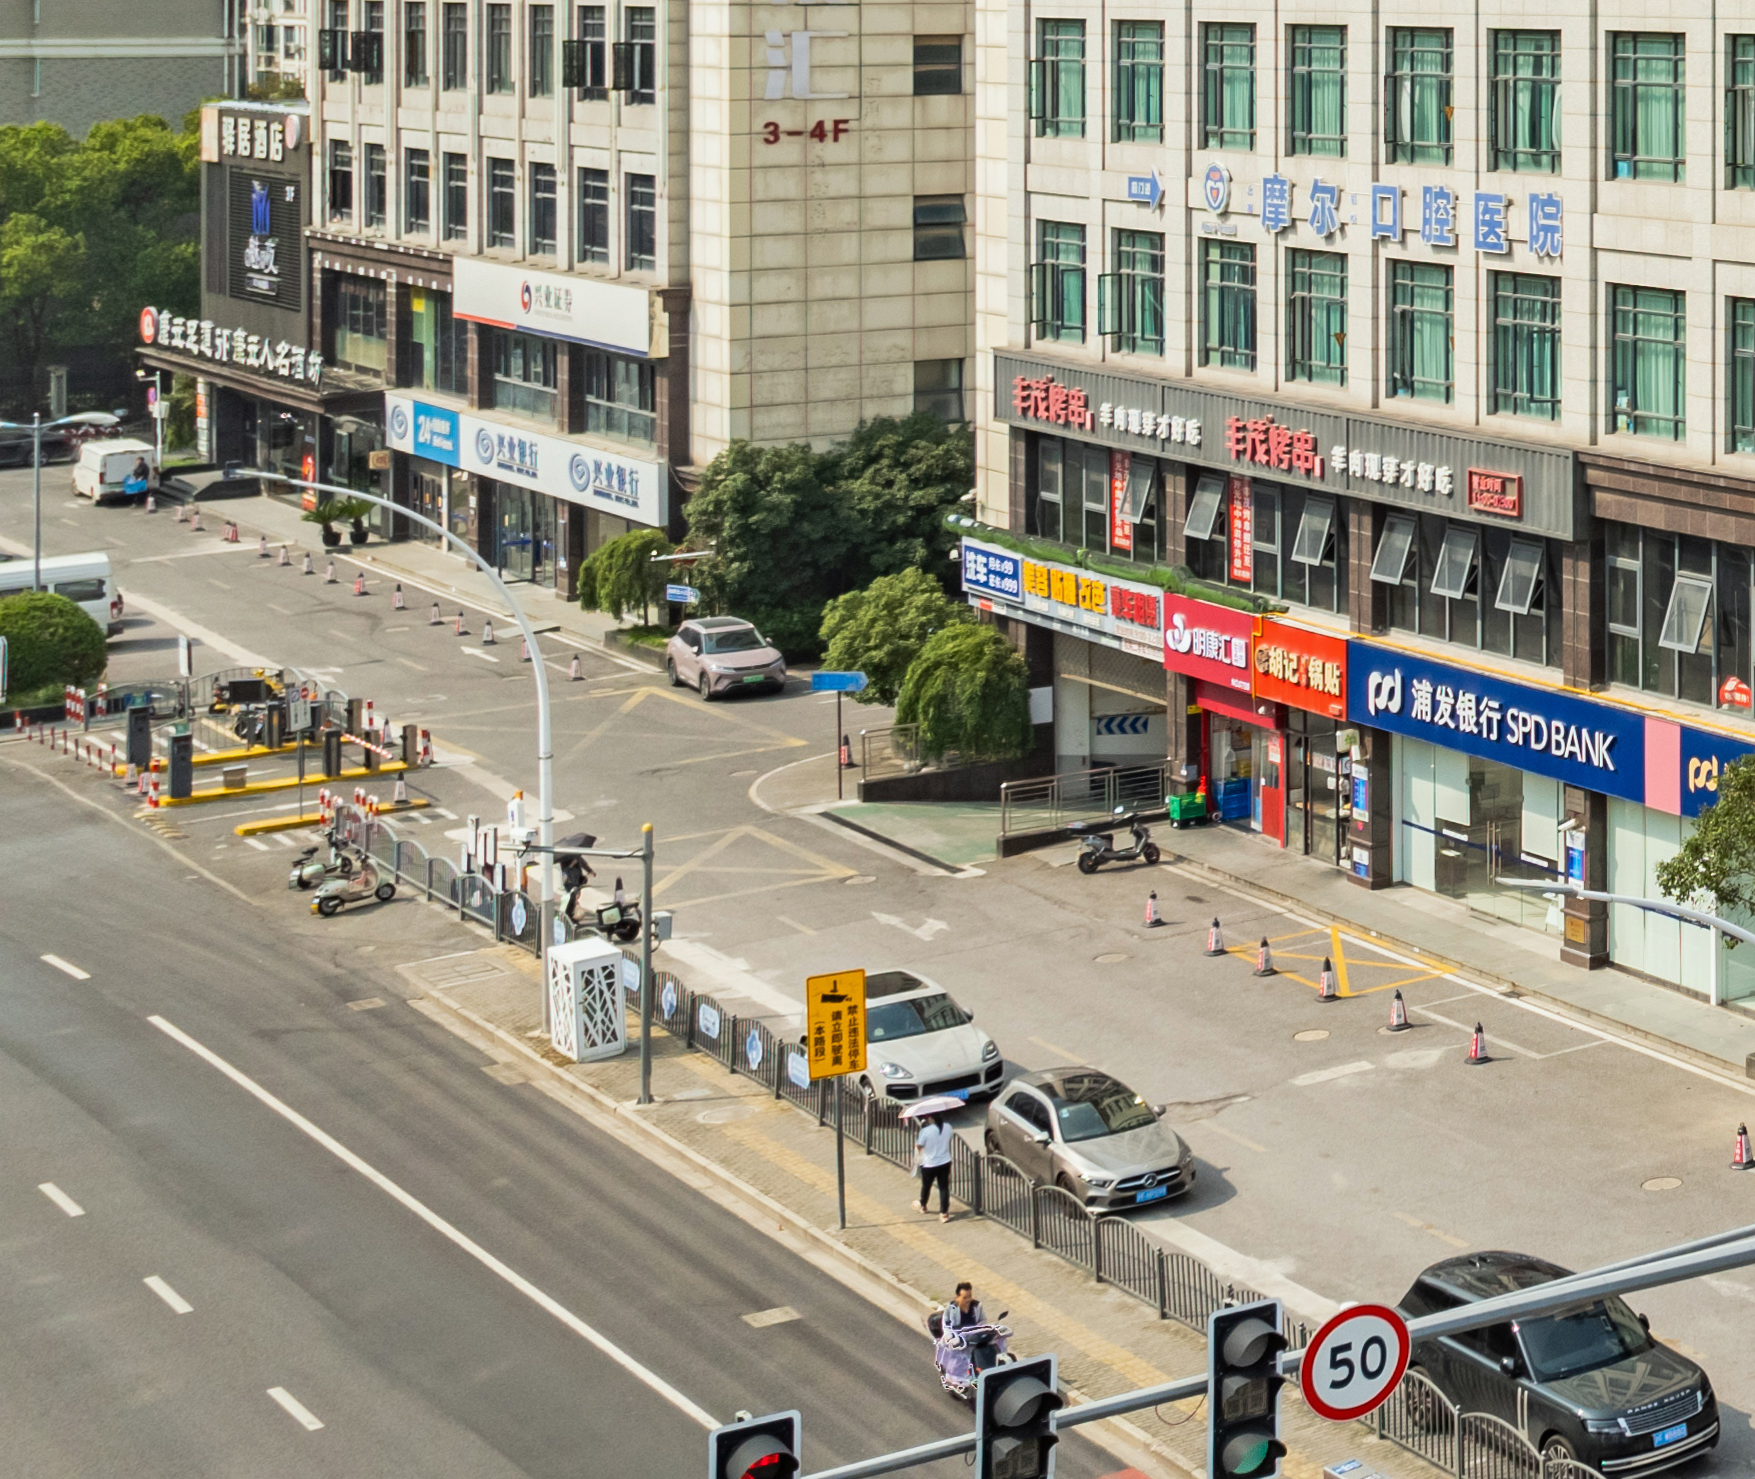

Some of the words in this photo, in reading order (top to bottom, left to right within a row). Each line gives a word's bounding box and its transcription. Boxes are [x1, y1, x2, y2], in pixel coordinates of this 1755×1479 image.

[1261, 171, 1565, 258] 摩尔口腔医院
[1012, 375, 1088, 429] 丰茂烤串
[497, 432, 539, 469] 兴业银行
[1224, 415, 1316, 479] 丰茂烤串
[593, 459, 640, 497] 兴业银行
[1191, 628, 1232, 665] 明康汇
[1268, 643, 1298, 686] 胡记
[1411, 679, 1501, 741] 浦发银行
[1506, 709, 1547, 751] SPD
[1552, 719, 1616, 771] BANK
[848, 1005, 859, 1070] 禁止违法停车
[1327, 1334, 1388, 1387] 50
